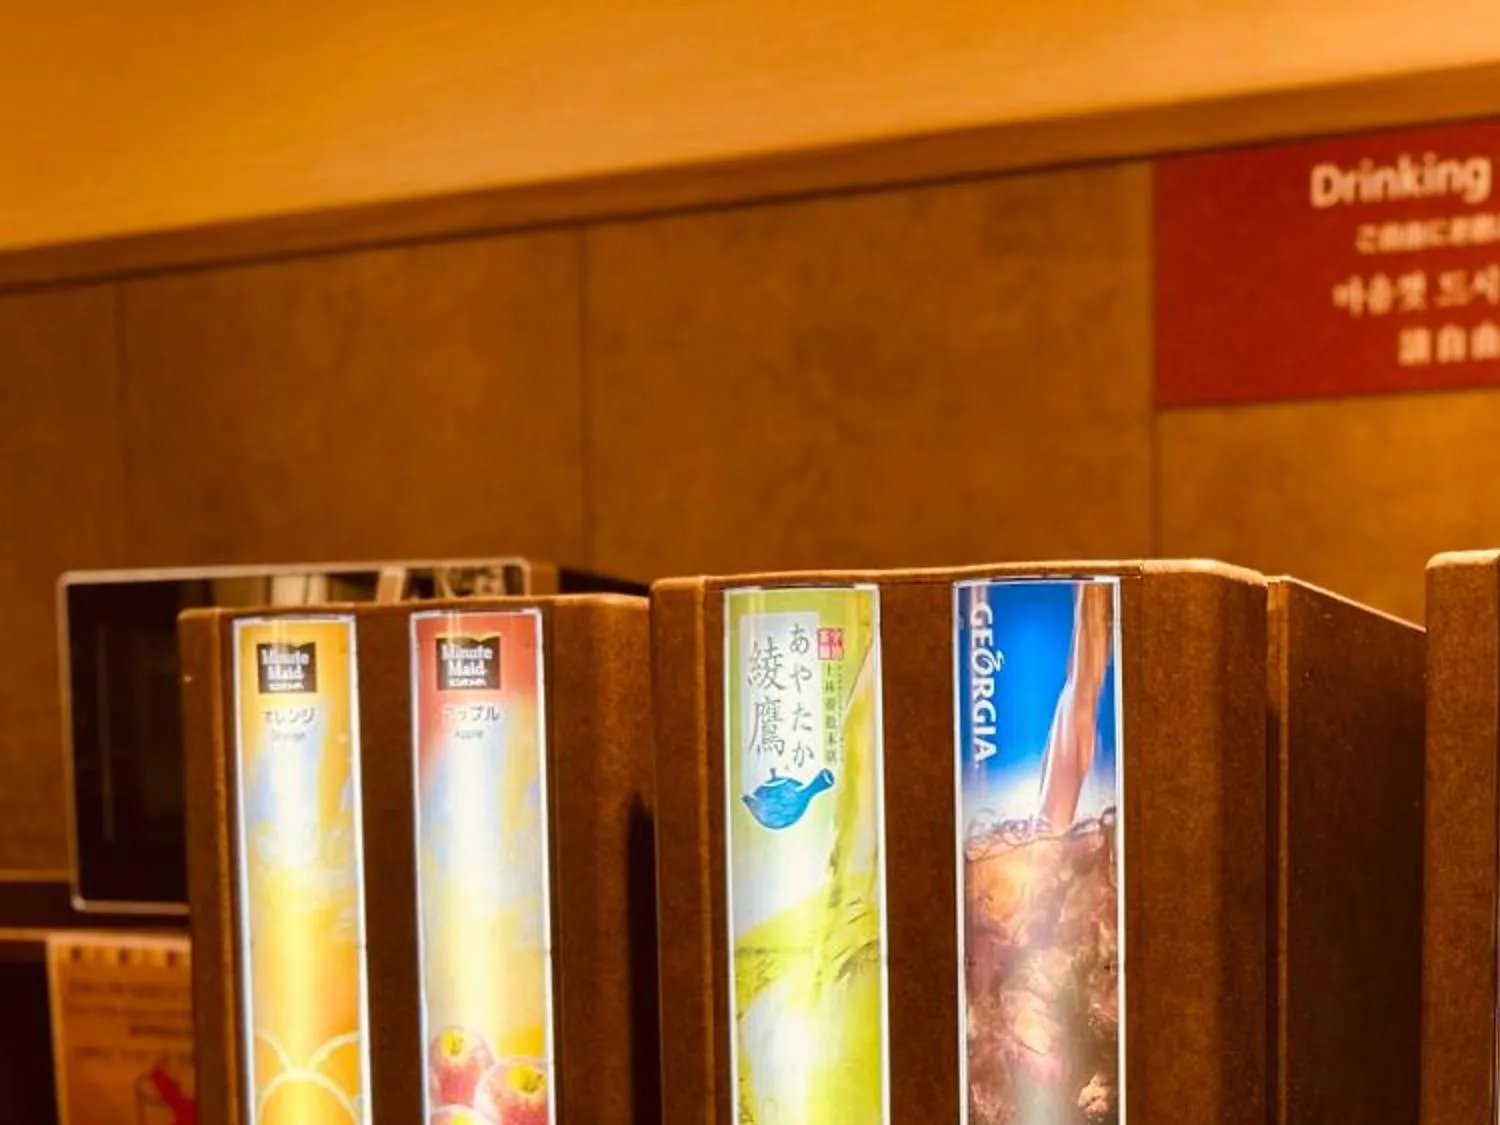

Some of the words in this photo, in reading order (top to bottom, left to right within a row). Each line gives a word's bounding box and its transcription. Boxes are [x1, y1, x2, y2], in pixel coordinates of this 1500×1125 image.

[1311, 149, 1492, 209] Drinking
[748, 636, 786, 757] 綾鷹
[789, 623, 814, 769] あやたか
[970, 602, 1004, 762] GEORGIA
